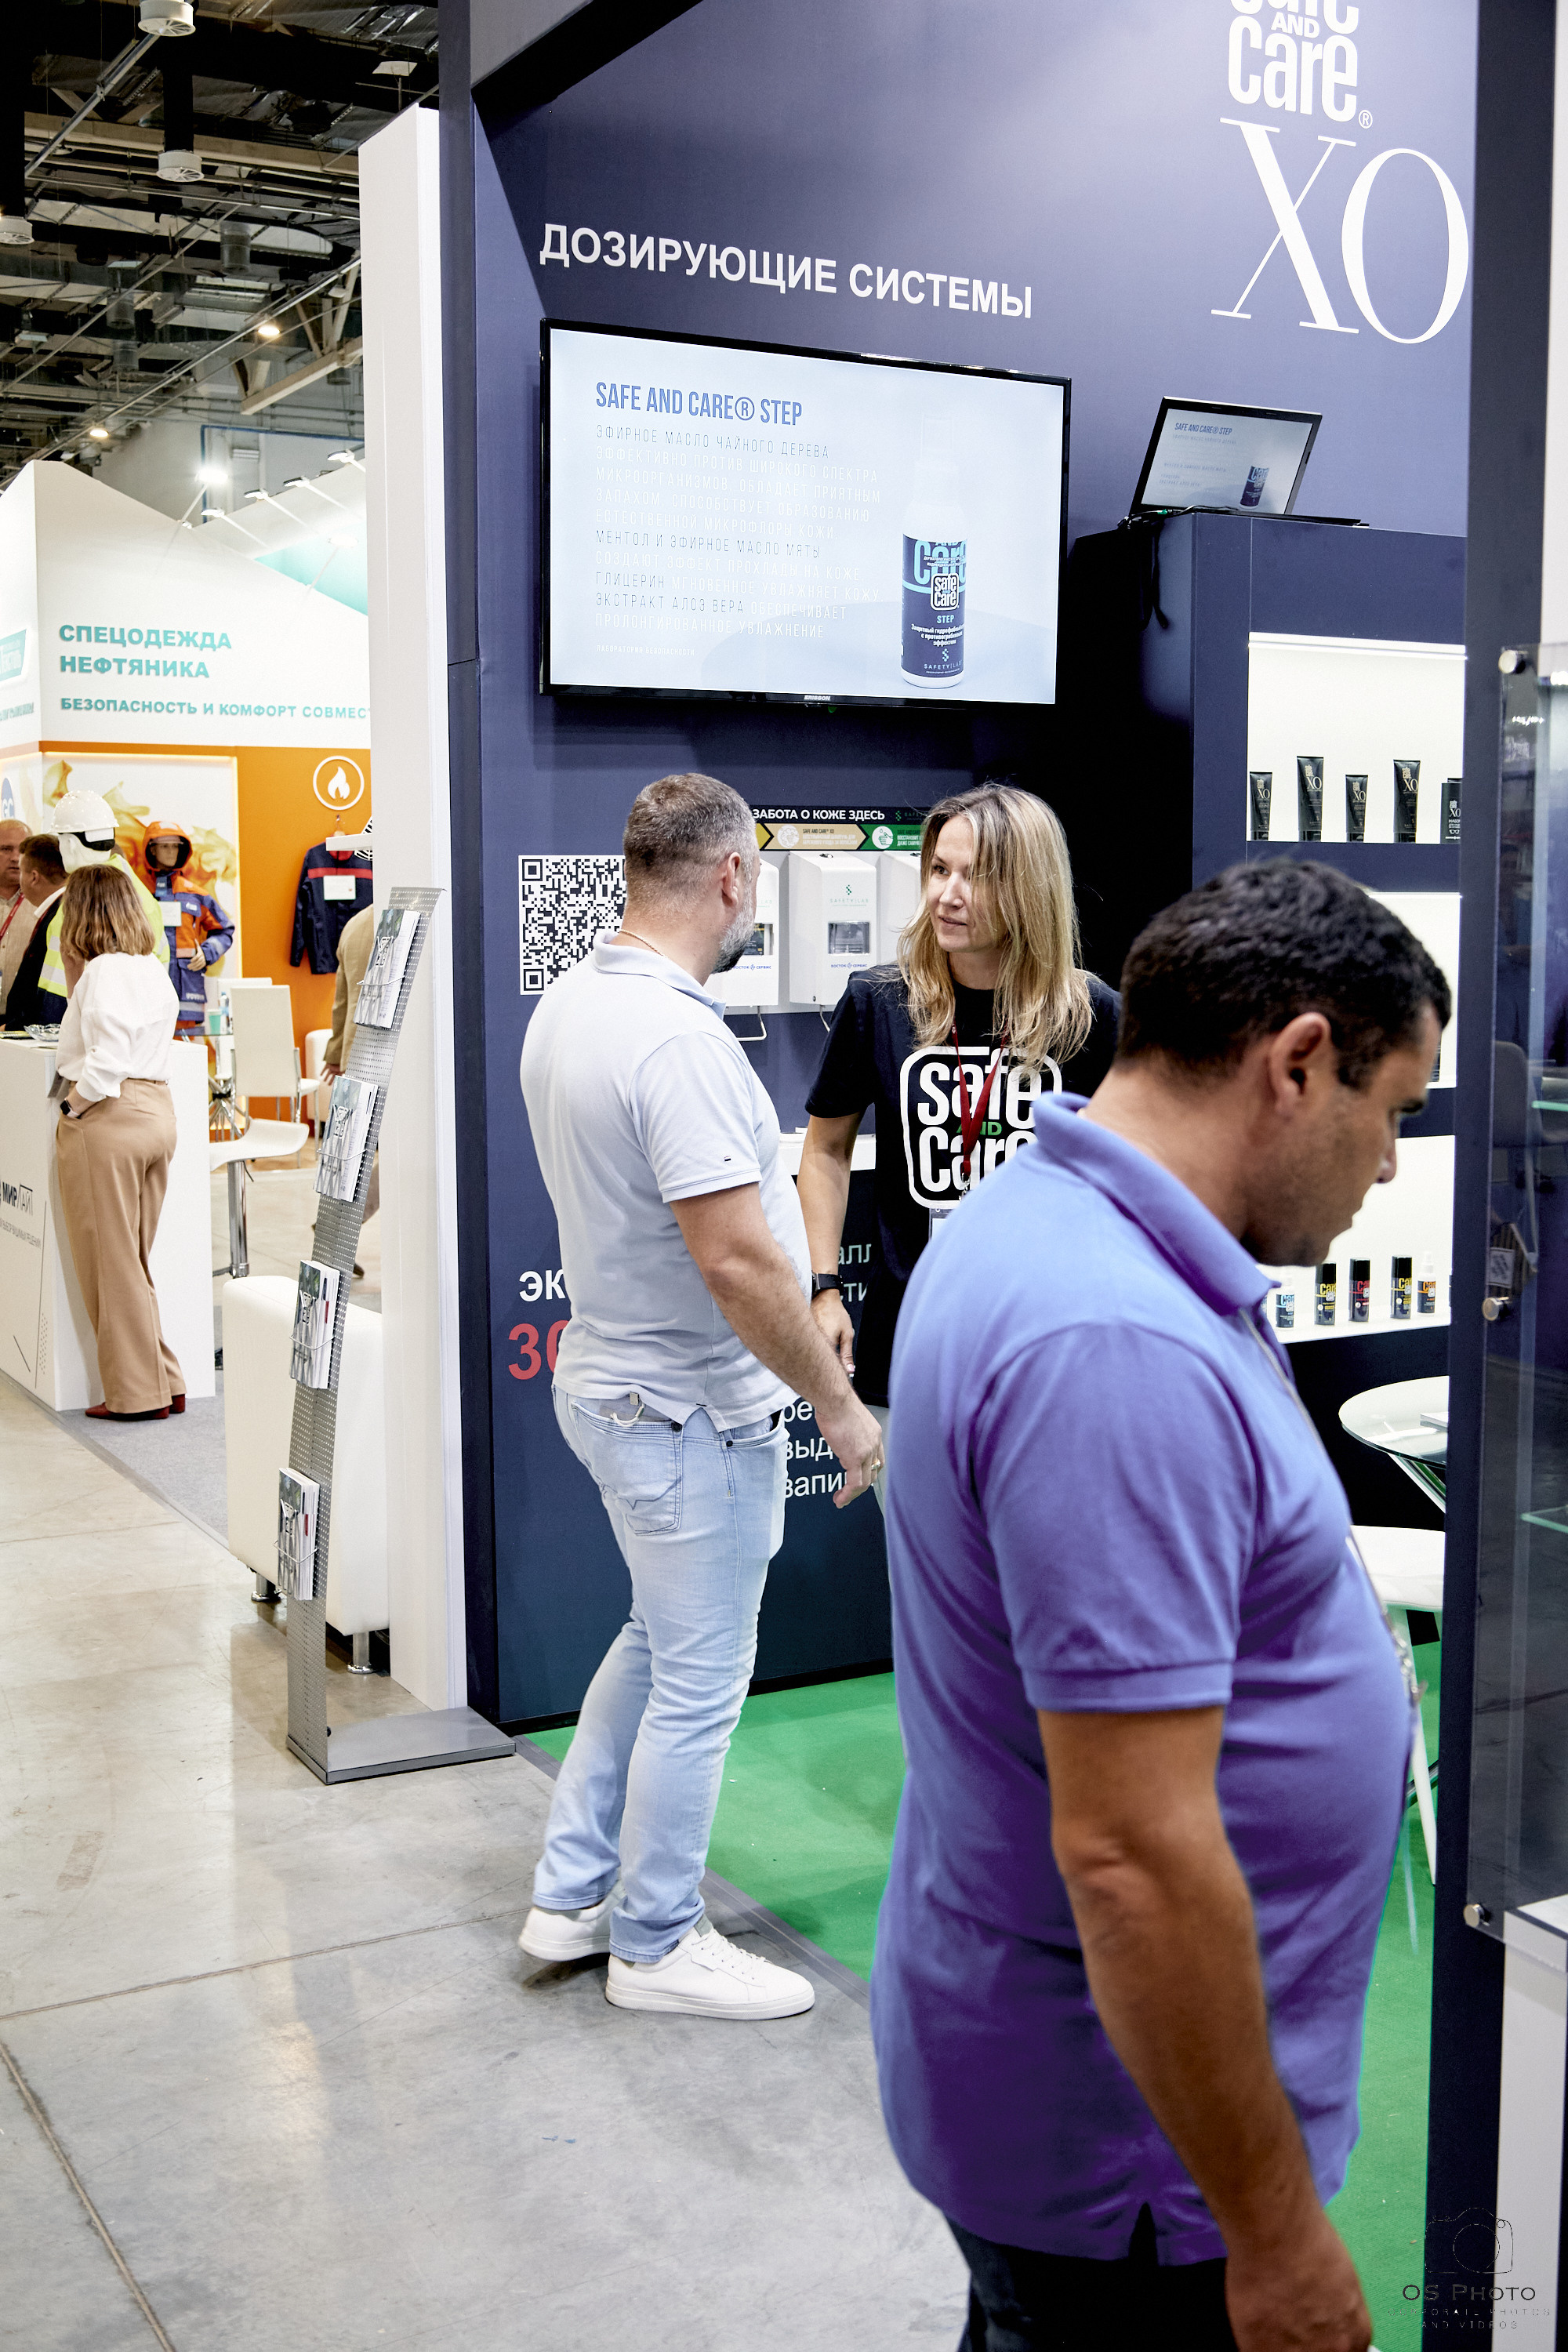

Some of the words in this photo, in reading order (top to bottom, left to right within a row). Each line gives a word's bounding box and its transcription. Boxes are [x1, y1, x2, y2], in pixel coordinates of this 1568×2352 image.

[1271, 11, 1320, 38] AND
[1211, 118, 1469, 344] XO
[540, 223, 837, 294] ДОЗИРУЮЩИЕ
[849, 263, 1032, 318] СИСТЕМЫ
[596, 381, 641, 411] SAFE
[646, 387, 683, 415] AND
[688, 391, 755, 422] CARE®
[760, 398, 803, 426] STEP
[1174, 423, 1189, 431] SAFE
[597, 424, 658, 443] ЭФИРНОЕ
[666, 431, 710, 448] МАСЛО
[717, 434, 775, 454] ЧАЙНОГО
[781, 442, 829, 459] ДЕРЕВА
[597, 446, 687, 467] ЭФФЕКТИВНО
[694, 454, 743, 471] ПРОТИВ
[750, 459, 816, 477] ШИРОКОГО
[822, 464, 877, 483] СПЕКТРА
[740, 479, 808, 498] ОБЛАДАЕТ
[814, 485, 880, 503] ПРИЯТНЫМ
[672, 494, 770, 514] СПОСОБСТВУЕТ
[778, 503, 869, 522] ОБРАЗОВАНИЮ
[597, 509, 697, 529] ЕСТЕСТВЕННОЙ
[705, 517, 793, 536] МИКРОФЛОРЫ
[596, 530, 649, 546] МЕНТОЛ
[656, 534, 663, 547] И
[670, 535, 730, 552] ЭФИРНОЕ
[737, 539, 779, 556] МАСЛО
[786, 543, 820, 558] МЯТЫ
[596, 550, 659, 568] СОЗДАЮТ
[667, 555, 721, 572] ЭФФЕКТ
[728, 560, 798, 577] ПРОХЛАДЫ
[804, 564, 819, 579] НА
[596, 572, 665, 589] ГЛИЦЕРИН
[672, 576, 755, 594] МГНОВЕННОЕ
[762, 583, 838, 600] УВЛАЖНЯЕТ
[596, 593, 665, 610] ЭКСТРАКТ
[672, 597, 706, 612] АЛОЭ
[713, 599, 744, 613] ВЕРА
[751, 601, 847, 620] ОБЕСПЕЧИВАЕТ
[937, 615, 954, 624] STEP
[60, 624, 232, 650] СПЕЦОДЕЖДА
[595, 613, 732, 633] ПРОЛОНГИРОВАННОЕ
[739, 621, 824, 638] УВЛАЖНЕНИЕ
[597, 644, 644, 654] ЛАБОРАТОРИЯ
[645, 646, 695, 656] БЕЗОПАСНОСТИ
[60, 655, 210, 678] НЕФТЯНИКА
[60, 697, 198, 714] БЕЗОПАСНОСТЬ
[204, 702, 214, 715] И
[219, 702, 297, 718] КОМФОРТ
[303, 706, 370, 719] СОВМЕС
[753, 808, 798, 819] ЗАБОТА
[800, 809, 810, 819] О
[813, 809, 846, 820] КОЖЕ
[848, 810, 885, 821] ЗДЕСЬ
